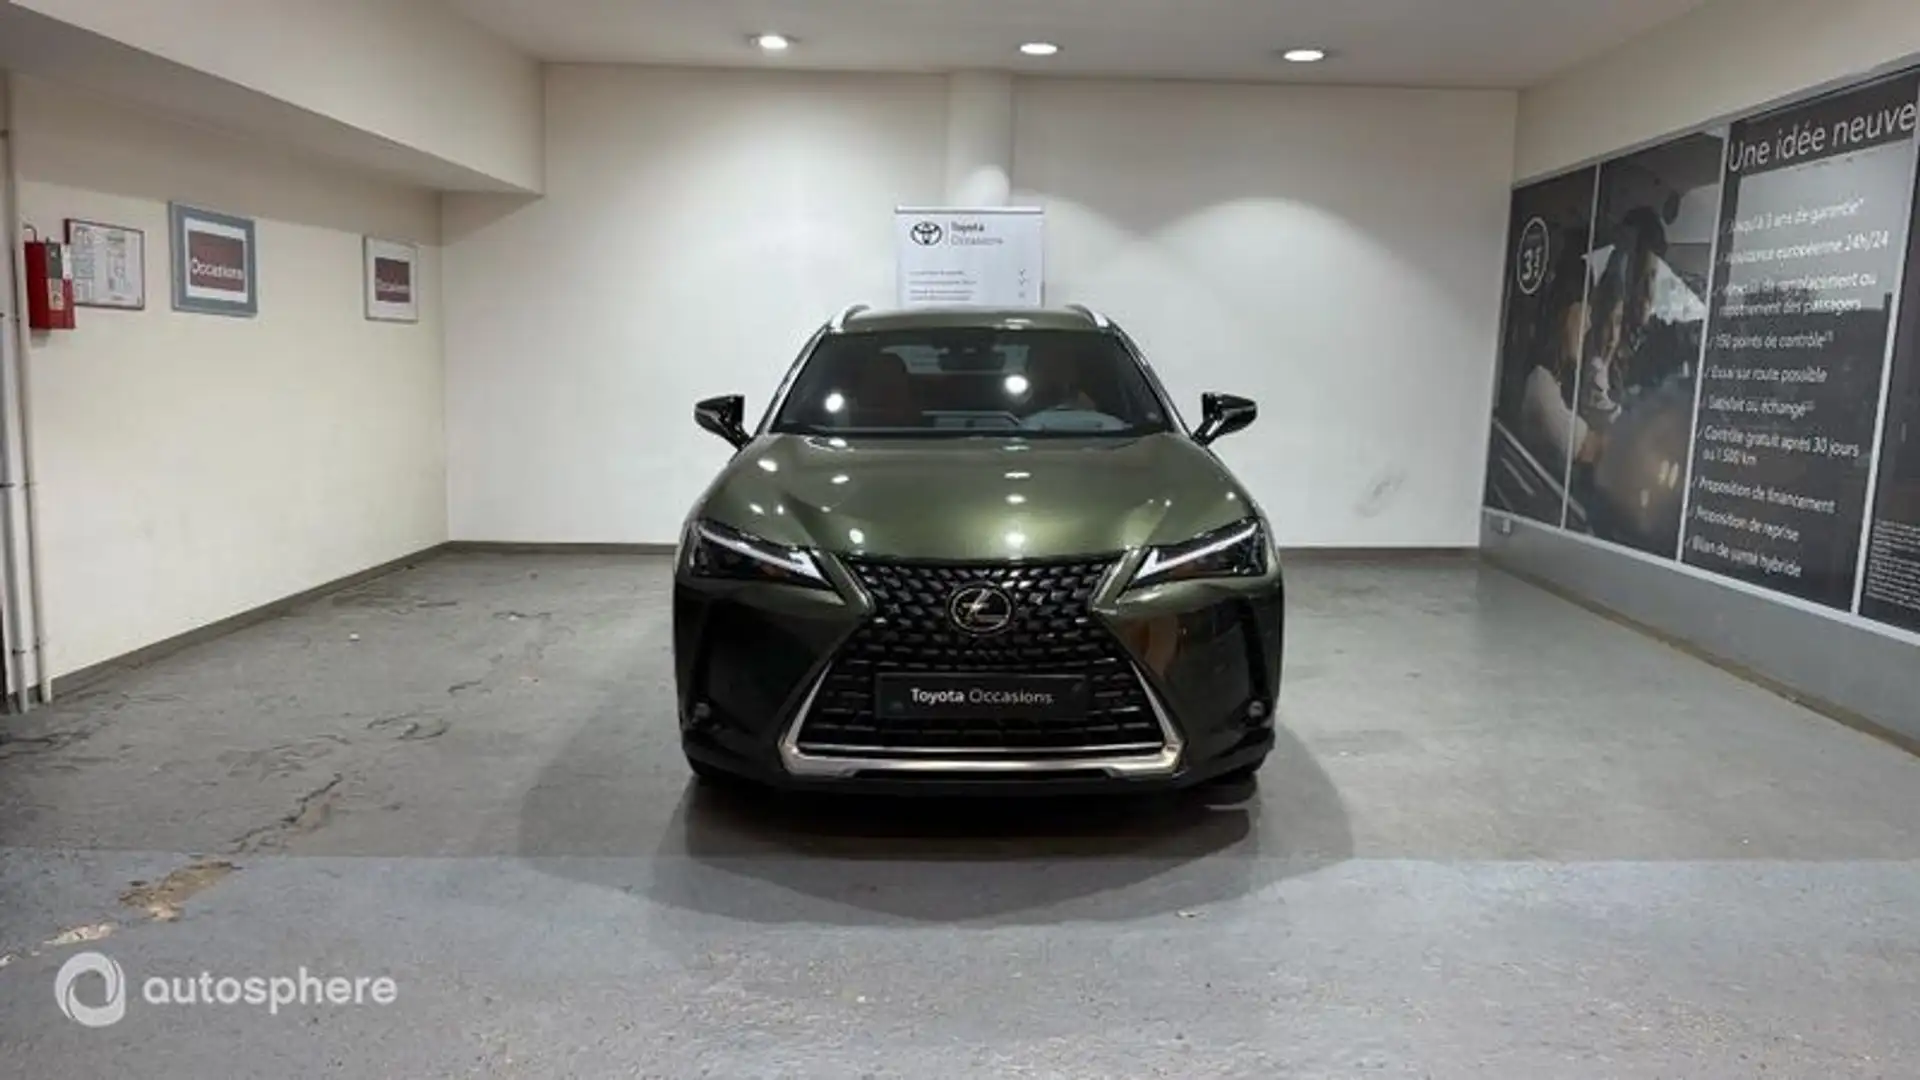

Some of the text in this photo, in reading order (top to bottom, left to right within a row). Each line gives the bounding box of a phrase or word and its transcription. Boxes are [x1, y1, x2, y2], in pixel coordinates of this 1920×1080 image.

[1728, 101, 1917, 172] Une idée neuve
[950, 221, 985, 234] Toyota
[190, 256, 245, 281] Occasions
[1752, 366, 1780, 381] route
[1780, 364, 1828, 384] possible
[1812, 436, 1828, 454] 30
[1828, 438, 1860, 458] jours
[1752, 484, 1766, 501] de
[1763, 523, 1801, 543] reprise
[910, 687, 1054, 706] Toyota Occasions
